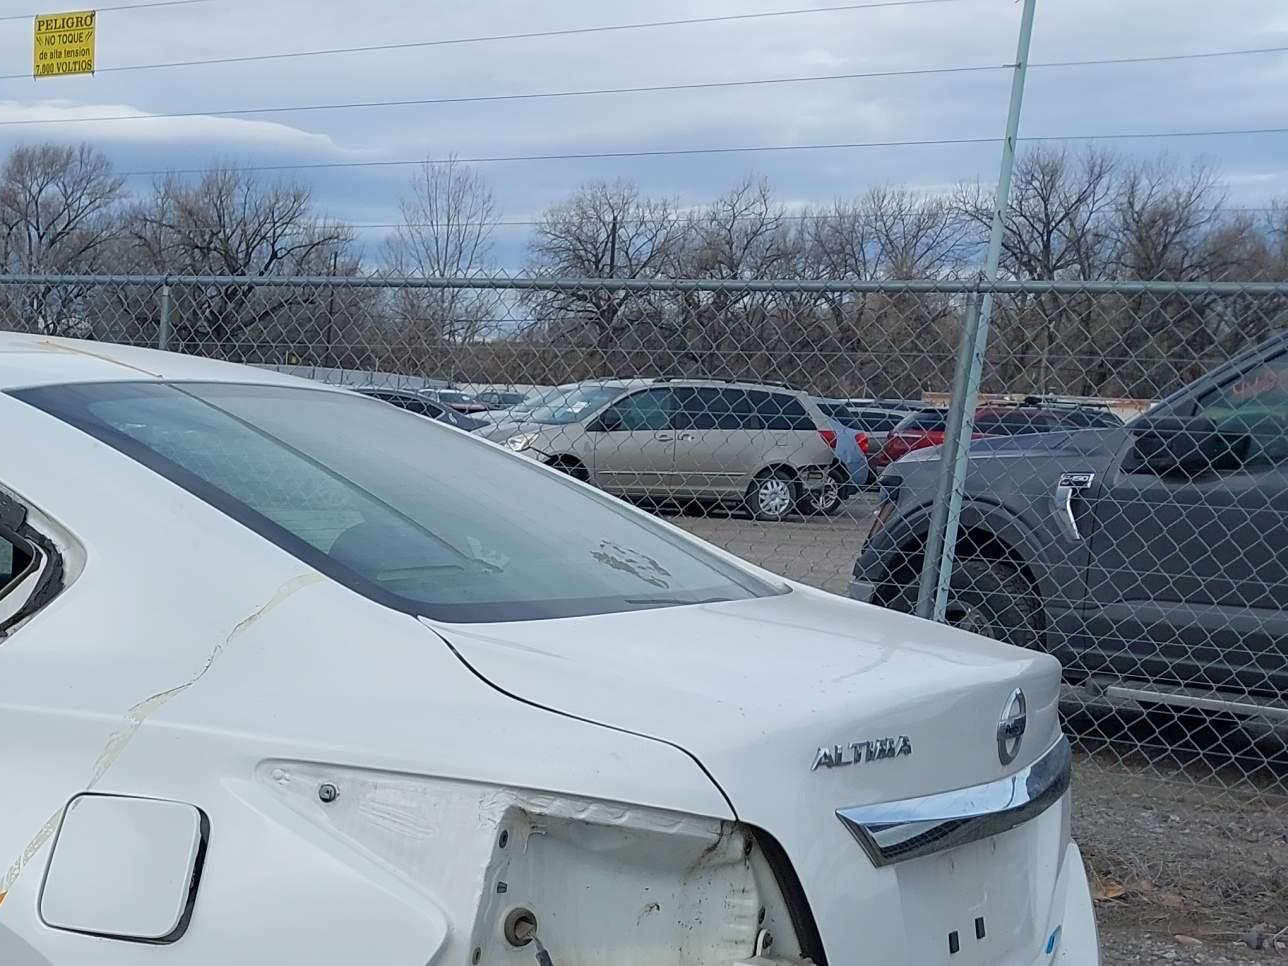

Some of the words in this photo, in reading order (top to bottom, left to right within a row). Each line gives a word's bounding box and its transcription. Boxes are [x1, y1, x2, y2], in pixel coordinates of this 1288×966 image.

[37, 15, 93, 31] PELIGRO
[44, 34, 56, 46] NO
[58, 32, 84, 45] TOQUE
[39, 49, 48, 60] de
[49, 48, 62, 59] alta
[56, 59, 92, 73] VOLTIOS
[810, 735, 913, 771] ALTIMA
